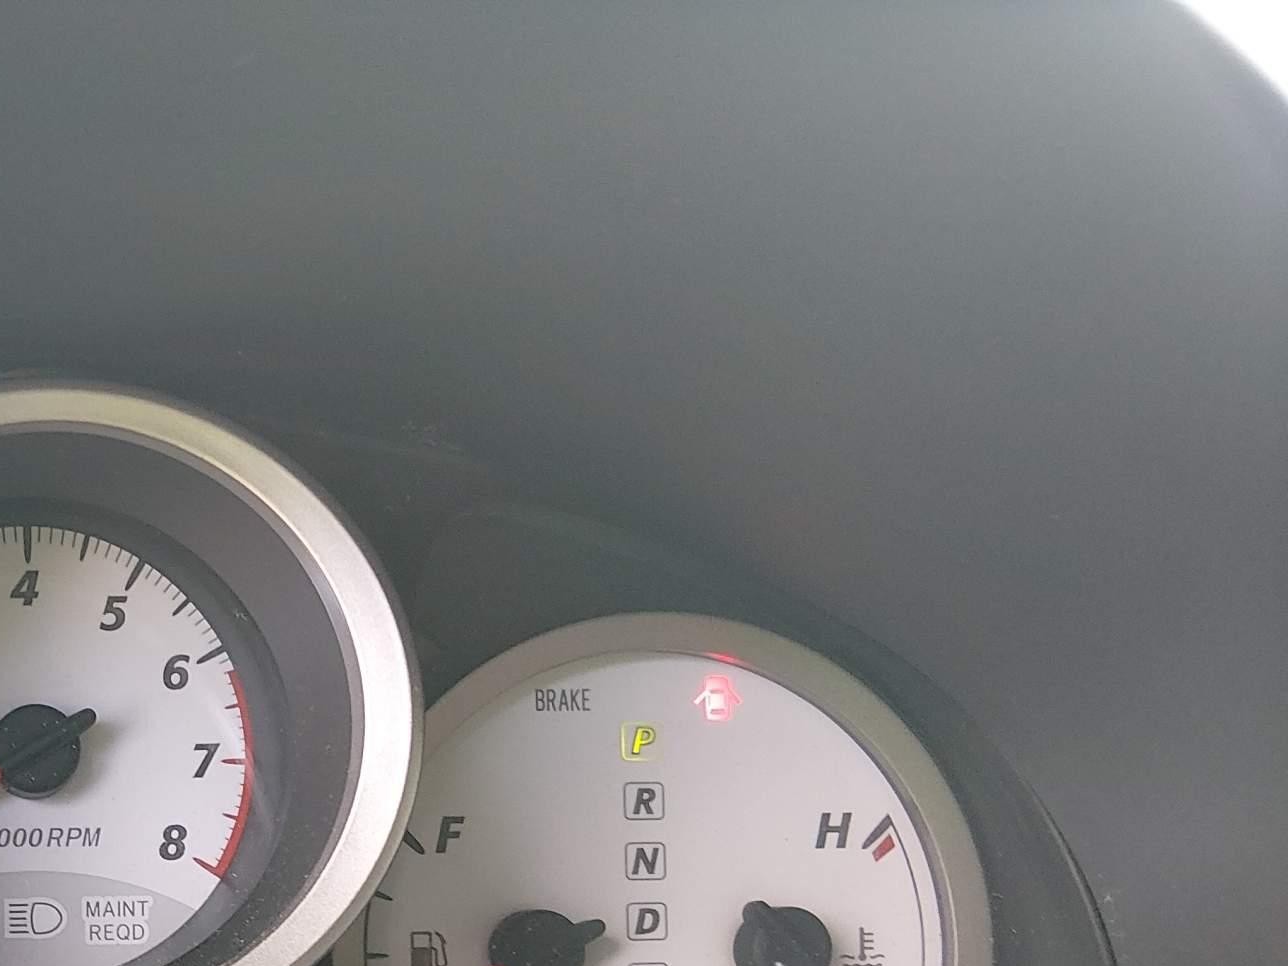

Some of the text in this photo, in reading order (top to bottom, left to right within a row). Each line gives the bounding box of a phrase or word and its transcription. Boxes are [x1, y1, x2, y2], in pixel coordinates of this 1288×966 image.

[11, 569, 39, 605] 4
[99, 594, 127, 630] 5
[162, 653, 190, 689] 6
[535, 688, 591, 712] BRAKE
[631, 726, 655, 755] P
[192, 742, 220, 777] 7
[632, 788, 656, 813] R
[47, 827, 102, 846] RPM
[158, 824, 187, 859] 8
[436, 815, 465, 853] F
[815, 812, 852, 848] H
[632, 848, 659, 874] N
[85, 901, 148, 916] MAINT
[635, 908, 660, 934] D
[89, 924, 145, 940] REQD
